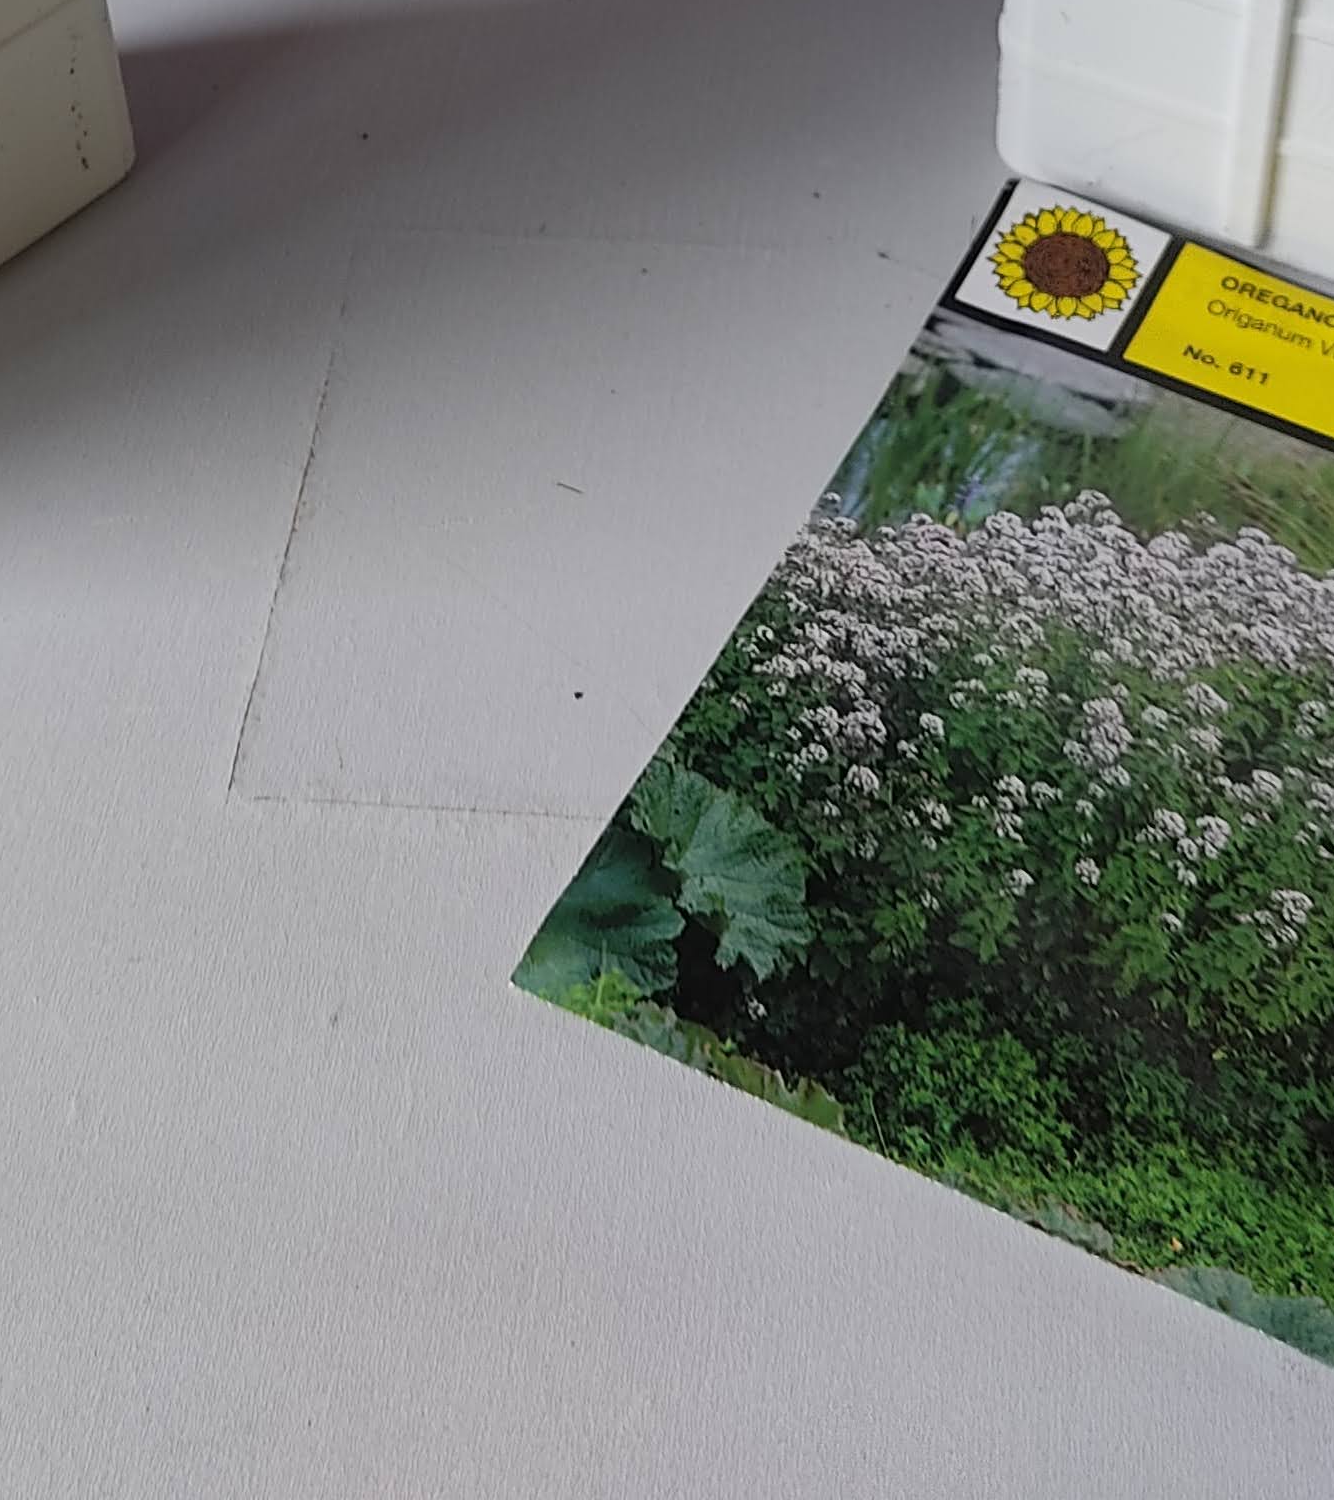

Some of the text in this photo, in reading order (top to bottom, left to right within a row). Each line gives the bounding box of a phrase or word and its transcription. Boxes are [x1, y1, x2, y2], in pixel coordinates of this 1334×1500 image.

[1206, 298, 1313, 350] Origanum
[1181, 343, 1270, 386] No. 611
